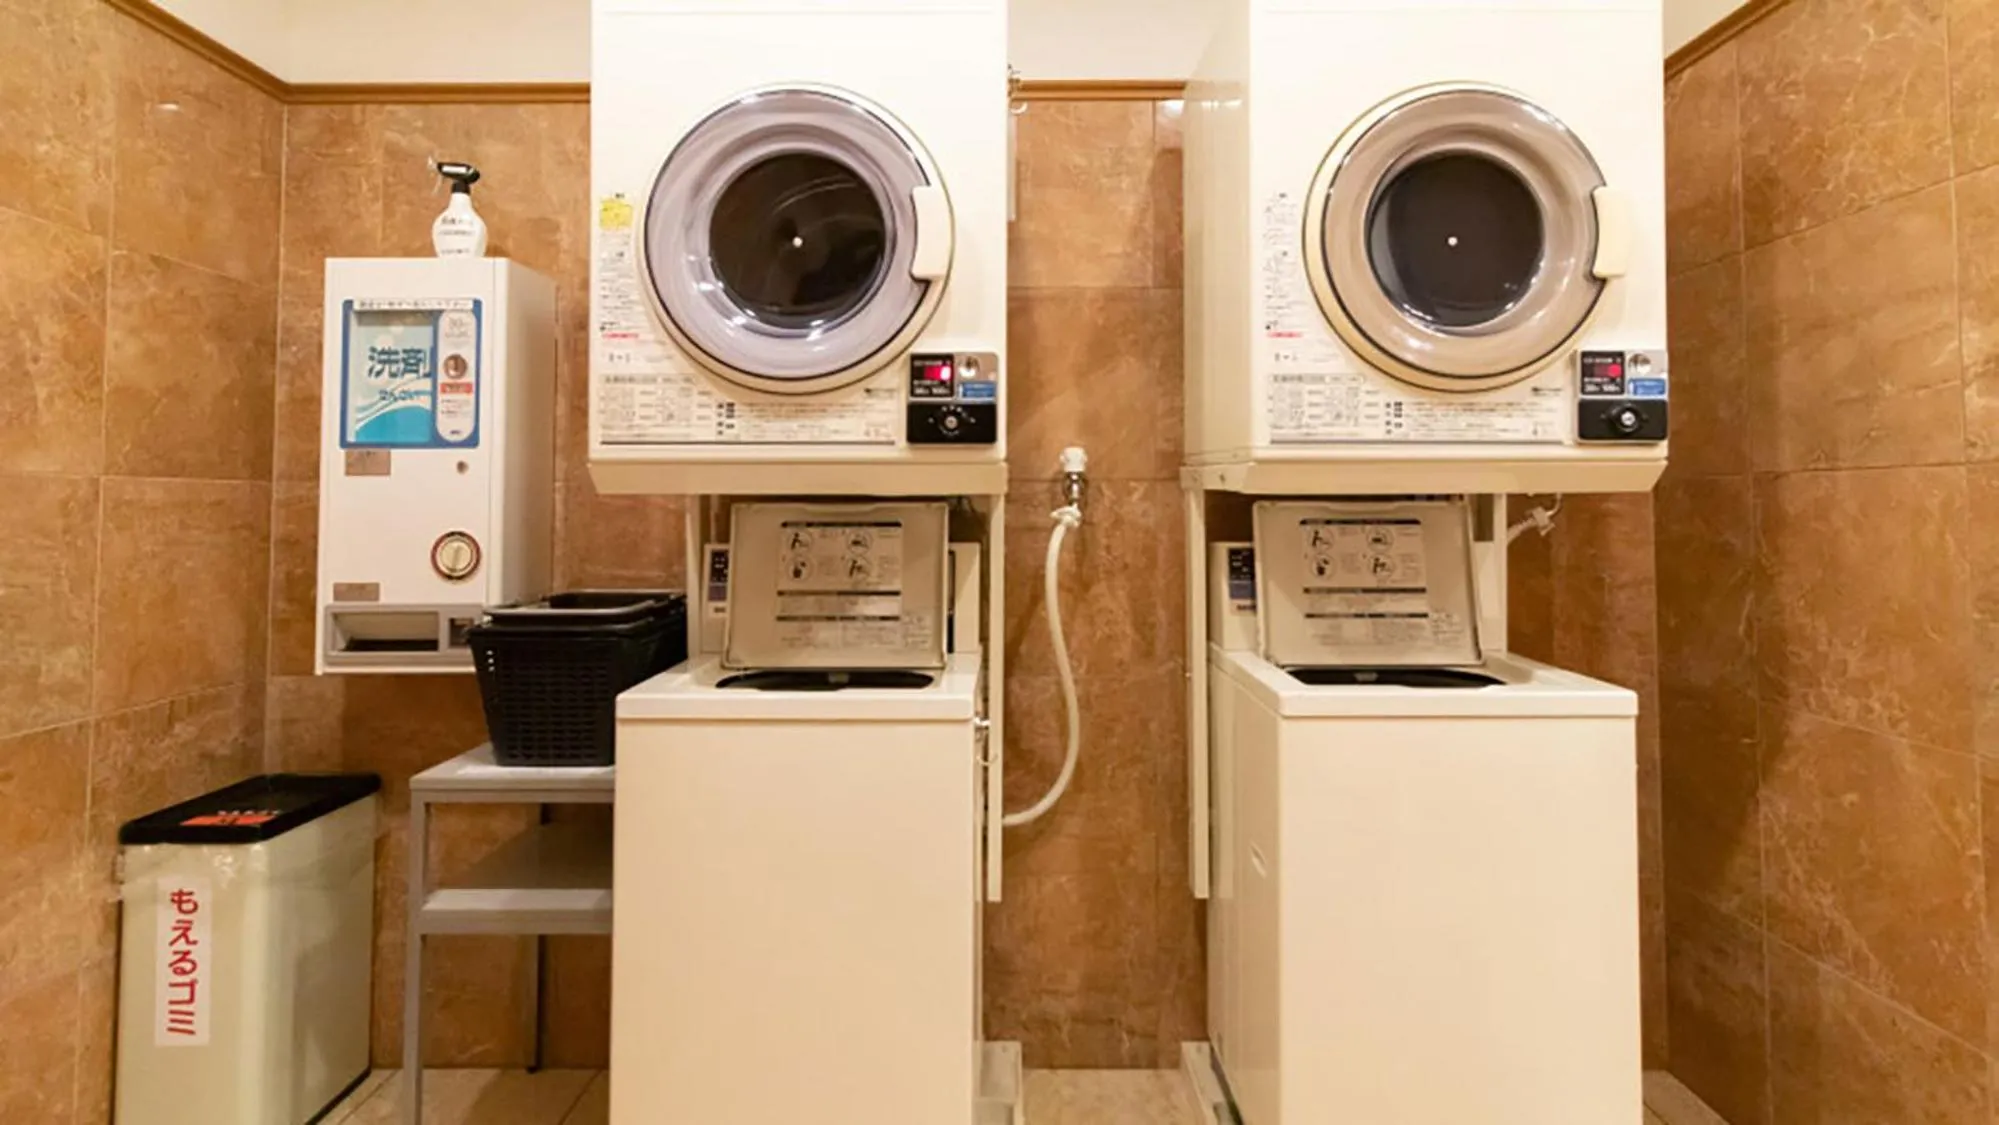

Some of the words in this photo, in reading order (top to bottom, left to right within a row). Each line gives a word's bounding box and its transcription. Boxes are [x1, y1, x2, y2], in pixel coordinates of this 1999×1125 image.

[368, 346, 431, 379] 洗剤
[167, 888, 199, 1036] もえるゴミ
